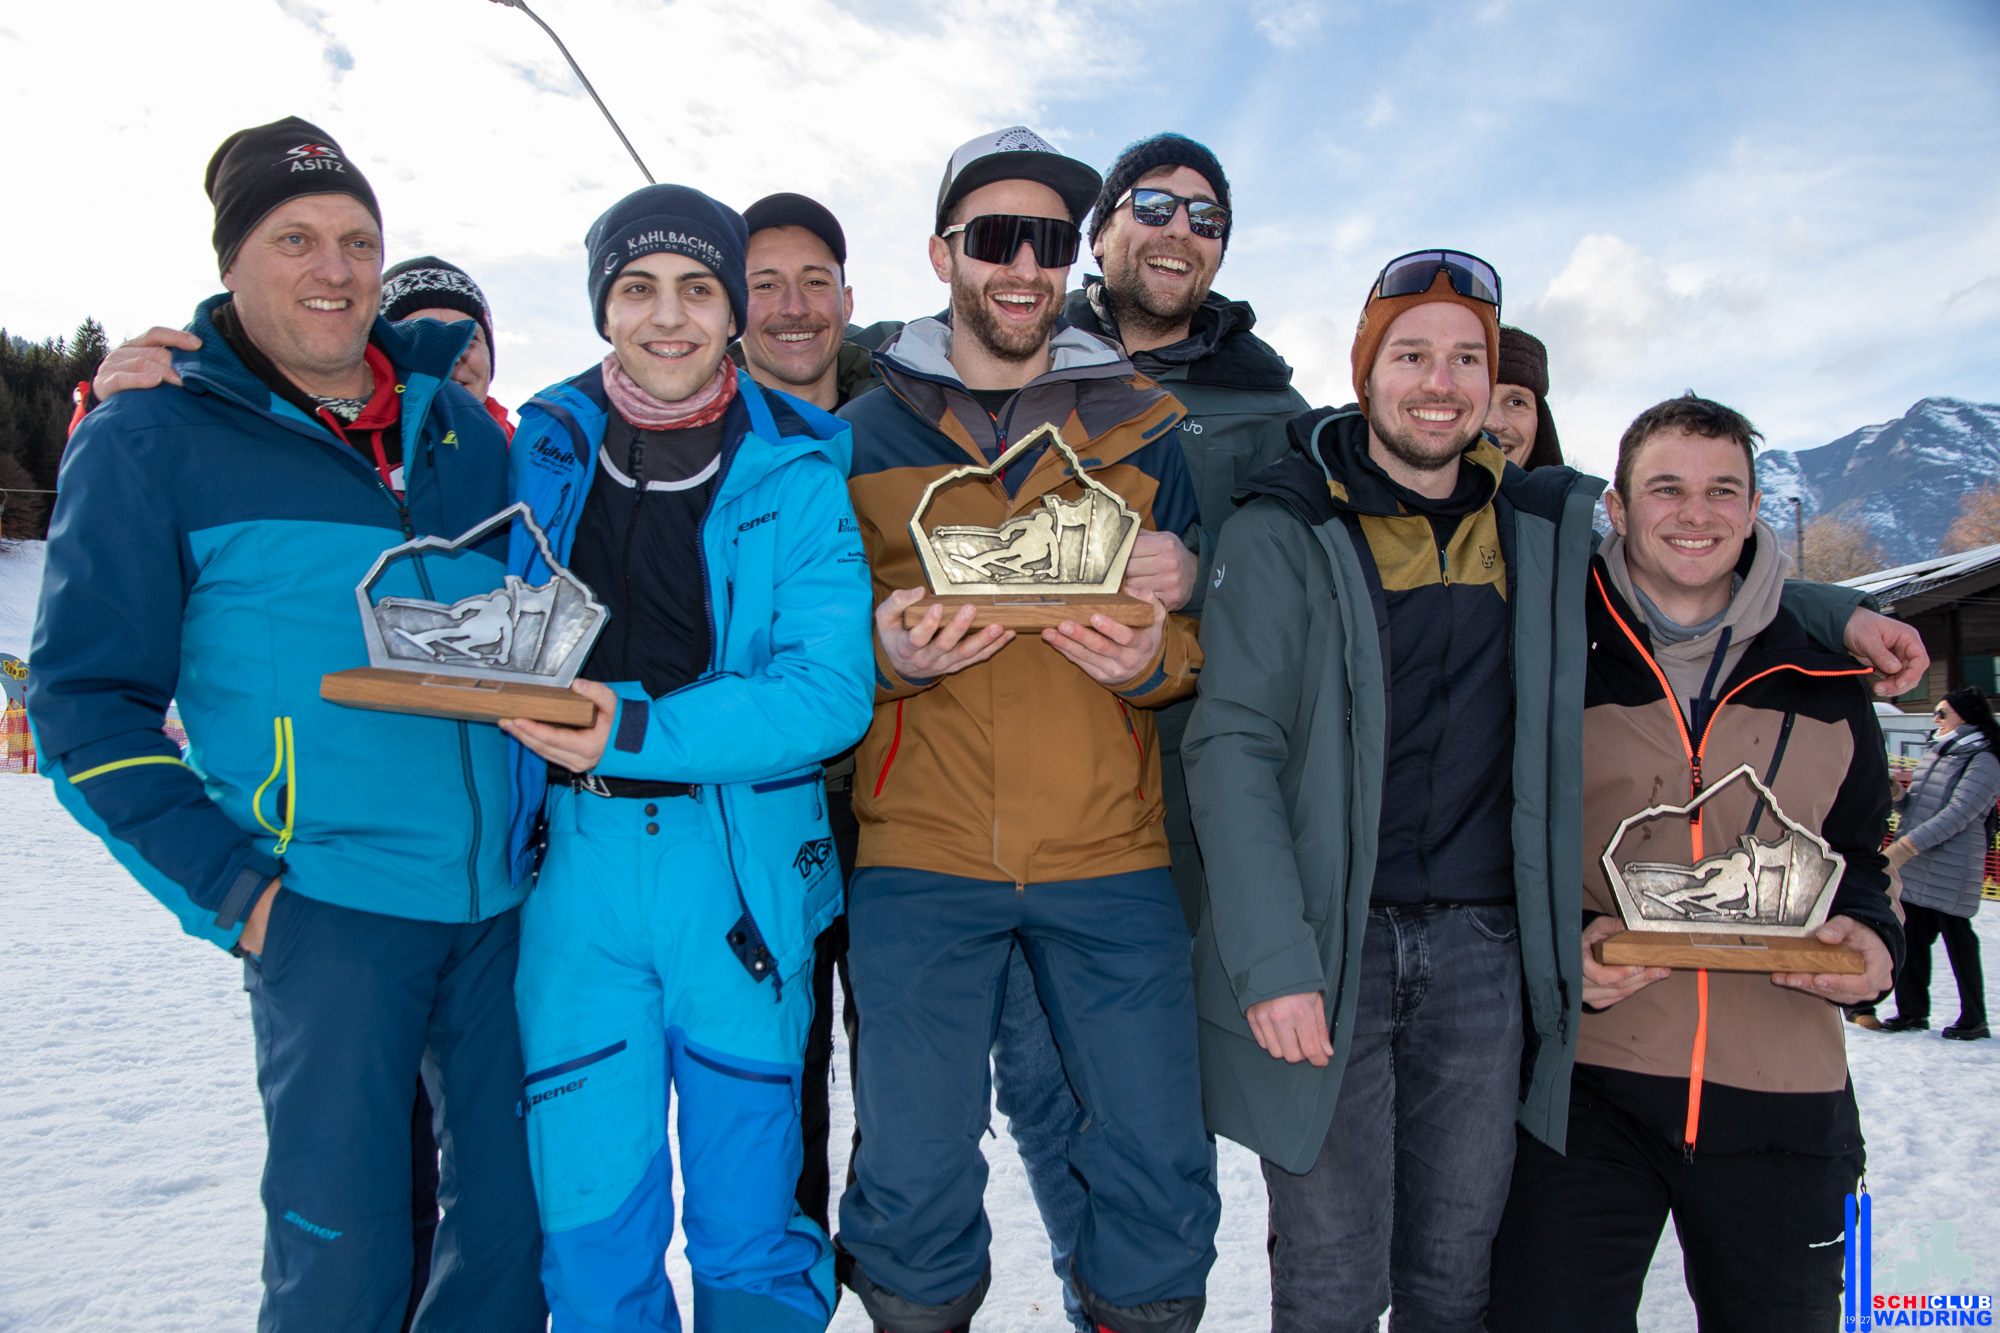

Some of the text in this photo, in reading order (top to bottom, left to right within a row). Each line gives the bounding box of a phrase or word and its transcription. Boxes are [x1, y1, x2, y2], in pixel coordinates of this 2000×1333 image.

[290, 158, 346, 173] ASITZ
[683, 246, 698, 256] THE
[738, 511, 778, 532] ener
